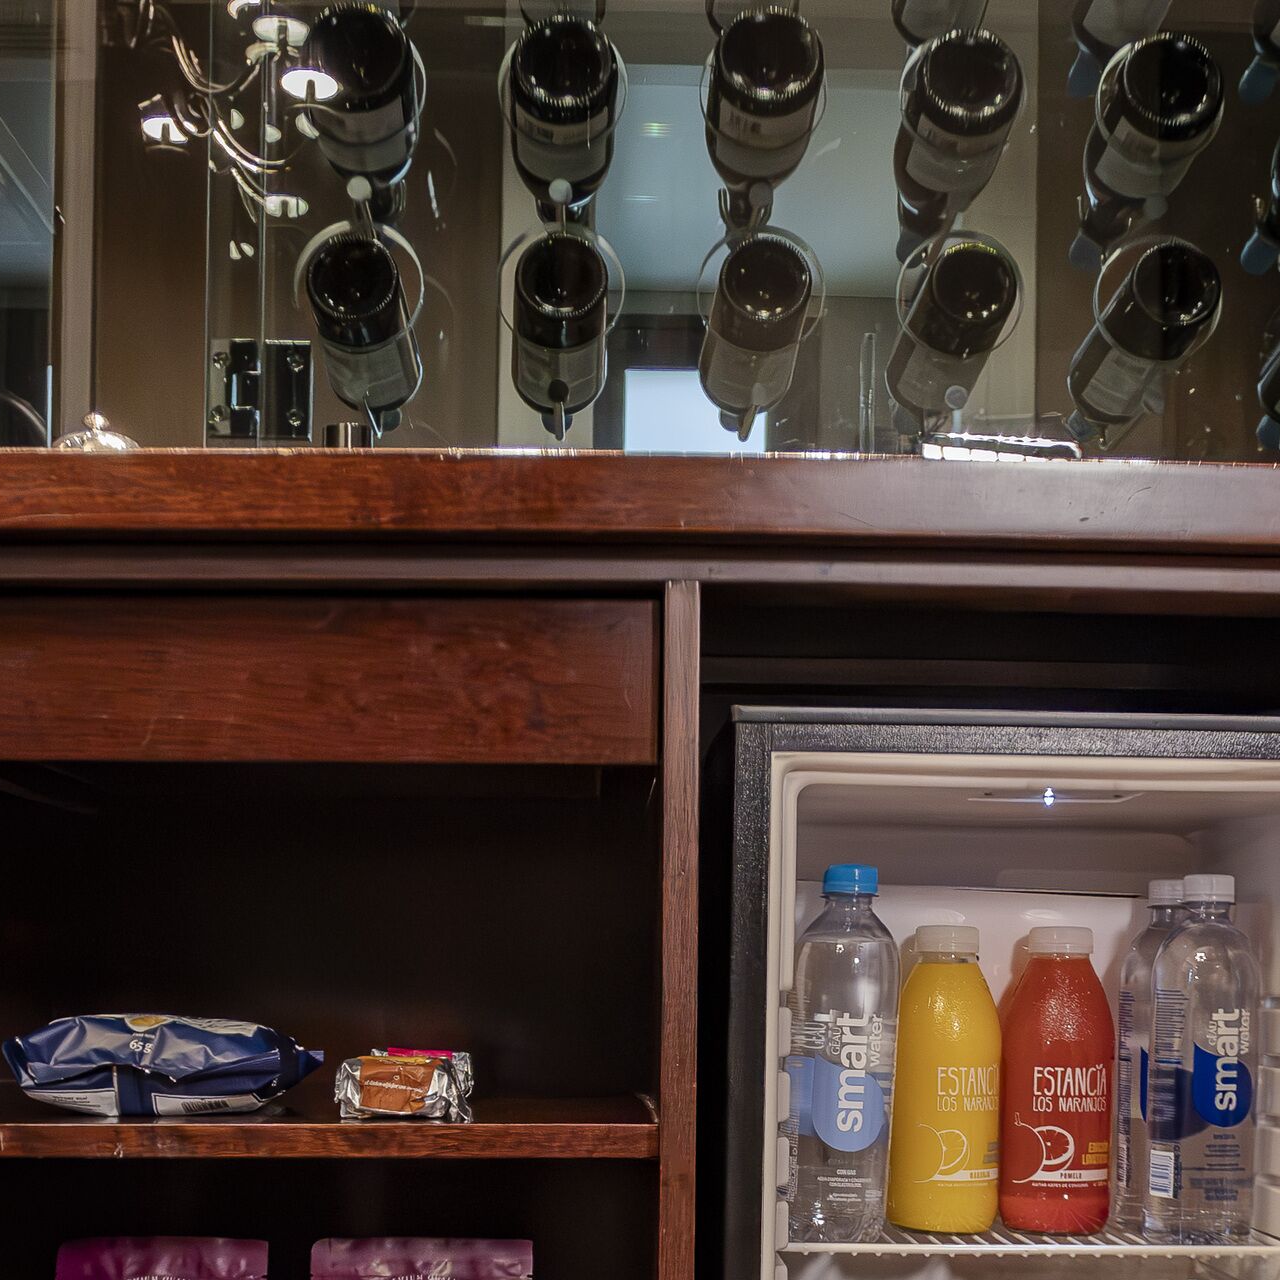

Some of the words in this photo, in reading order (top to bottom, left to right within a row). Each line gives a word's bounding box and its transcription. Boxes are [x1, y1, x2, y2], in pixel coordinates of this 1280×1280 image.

[129, 1039, 144, 1052] 65
[870, 1014, 884, 1067] water
[1238, 1008, 1251, 1054] water
[835, 1012, 870, 1133] smart
[1214, 1008, 1240, 1112] smart
[937, 1097, 957, 1112] LOS
[1032, 1096, 1053, 1113] LOS
[1058, 1096, 1107, 1113] NARANJOS
